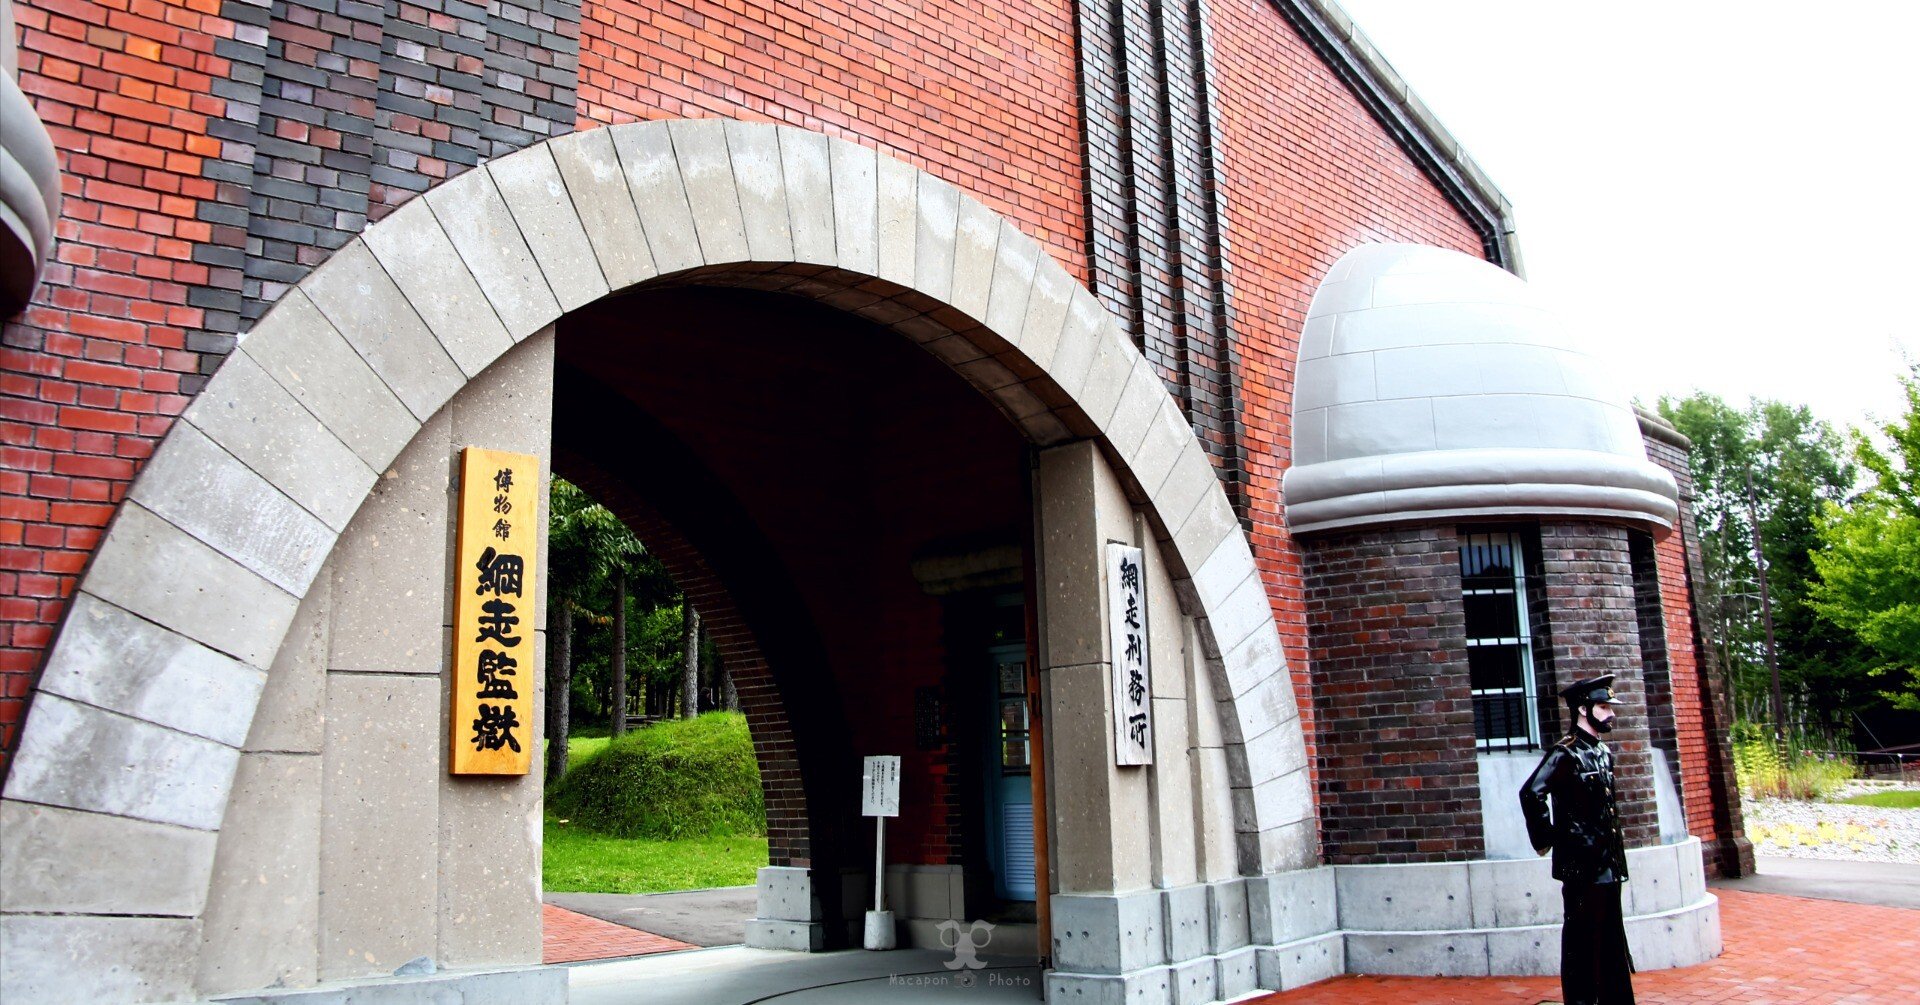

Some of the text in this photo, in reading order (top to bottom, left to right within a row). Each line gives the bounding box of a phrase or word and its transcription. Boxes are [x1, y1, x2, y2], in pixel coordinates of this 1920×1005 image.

[492, 468, 513, 541] 博物館
[471, 546, 523, 753] 網走監獄
[1120, 557, 1147, 749] 網走刑務所
